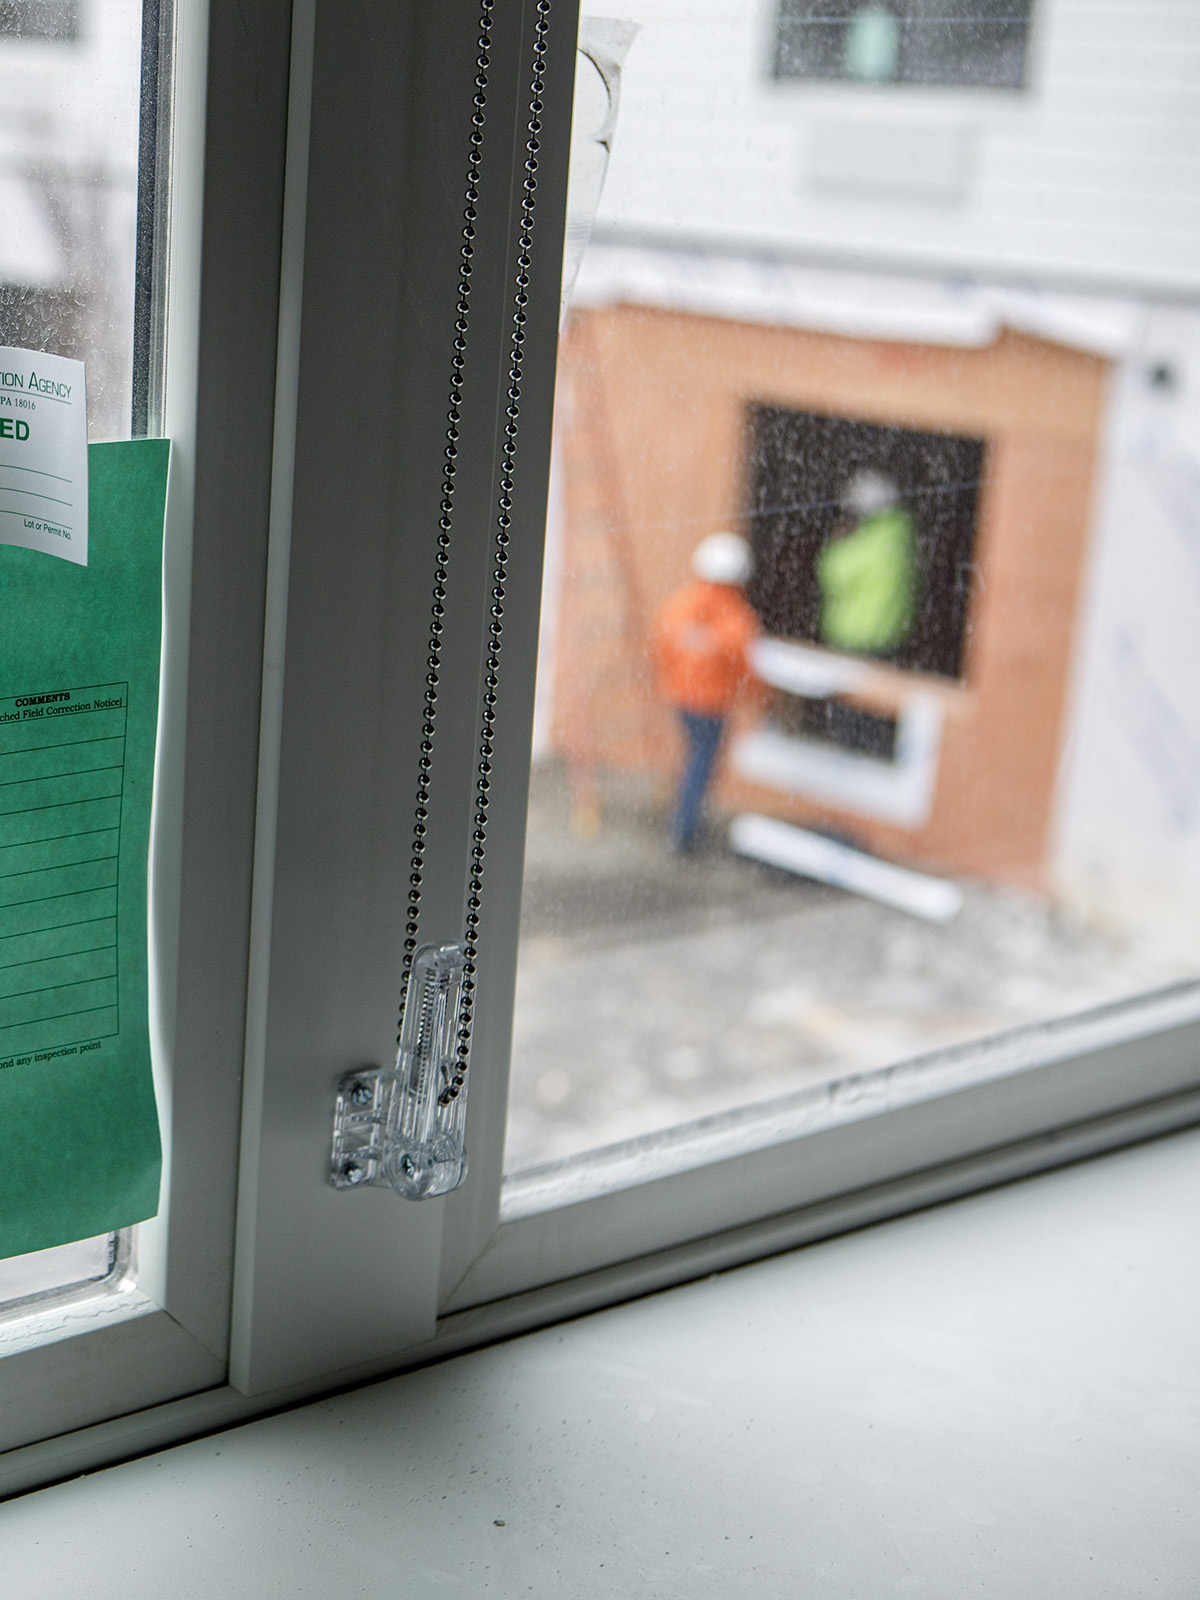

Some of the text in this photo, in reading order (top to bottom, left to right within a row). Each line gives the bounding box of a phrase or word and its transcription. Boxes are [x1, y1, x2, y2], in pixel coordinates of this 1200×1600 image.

[28, 372, 72, 399] AGENCY
[0, 396, 13, 406] PA
[14, 398, 36, 411] 18016
[24, 518, 73, 541] Lot or Permit No.
[14, 692, 70, 708] COMMENTS
[22, 706, 44, 720] Field
[46, 701, 91, 717] Correction
[93, 697, 122, 710] Notice)
[16, 1055, 32, 1068] any
[34, 1046, 78, 1064] inspection
[79, 1040, 102, 1055] point
